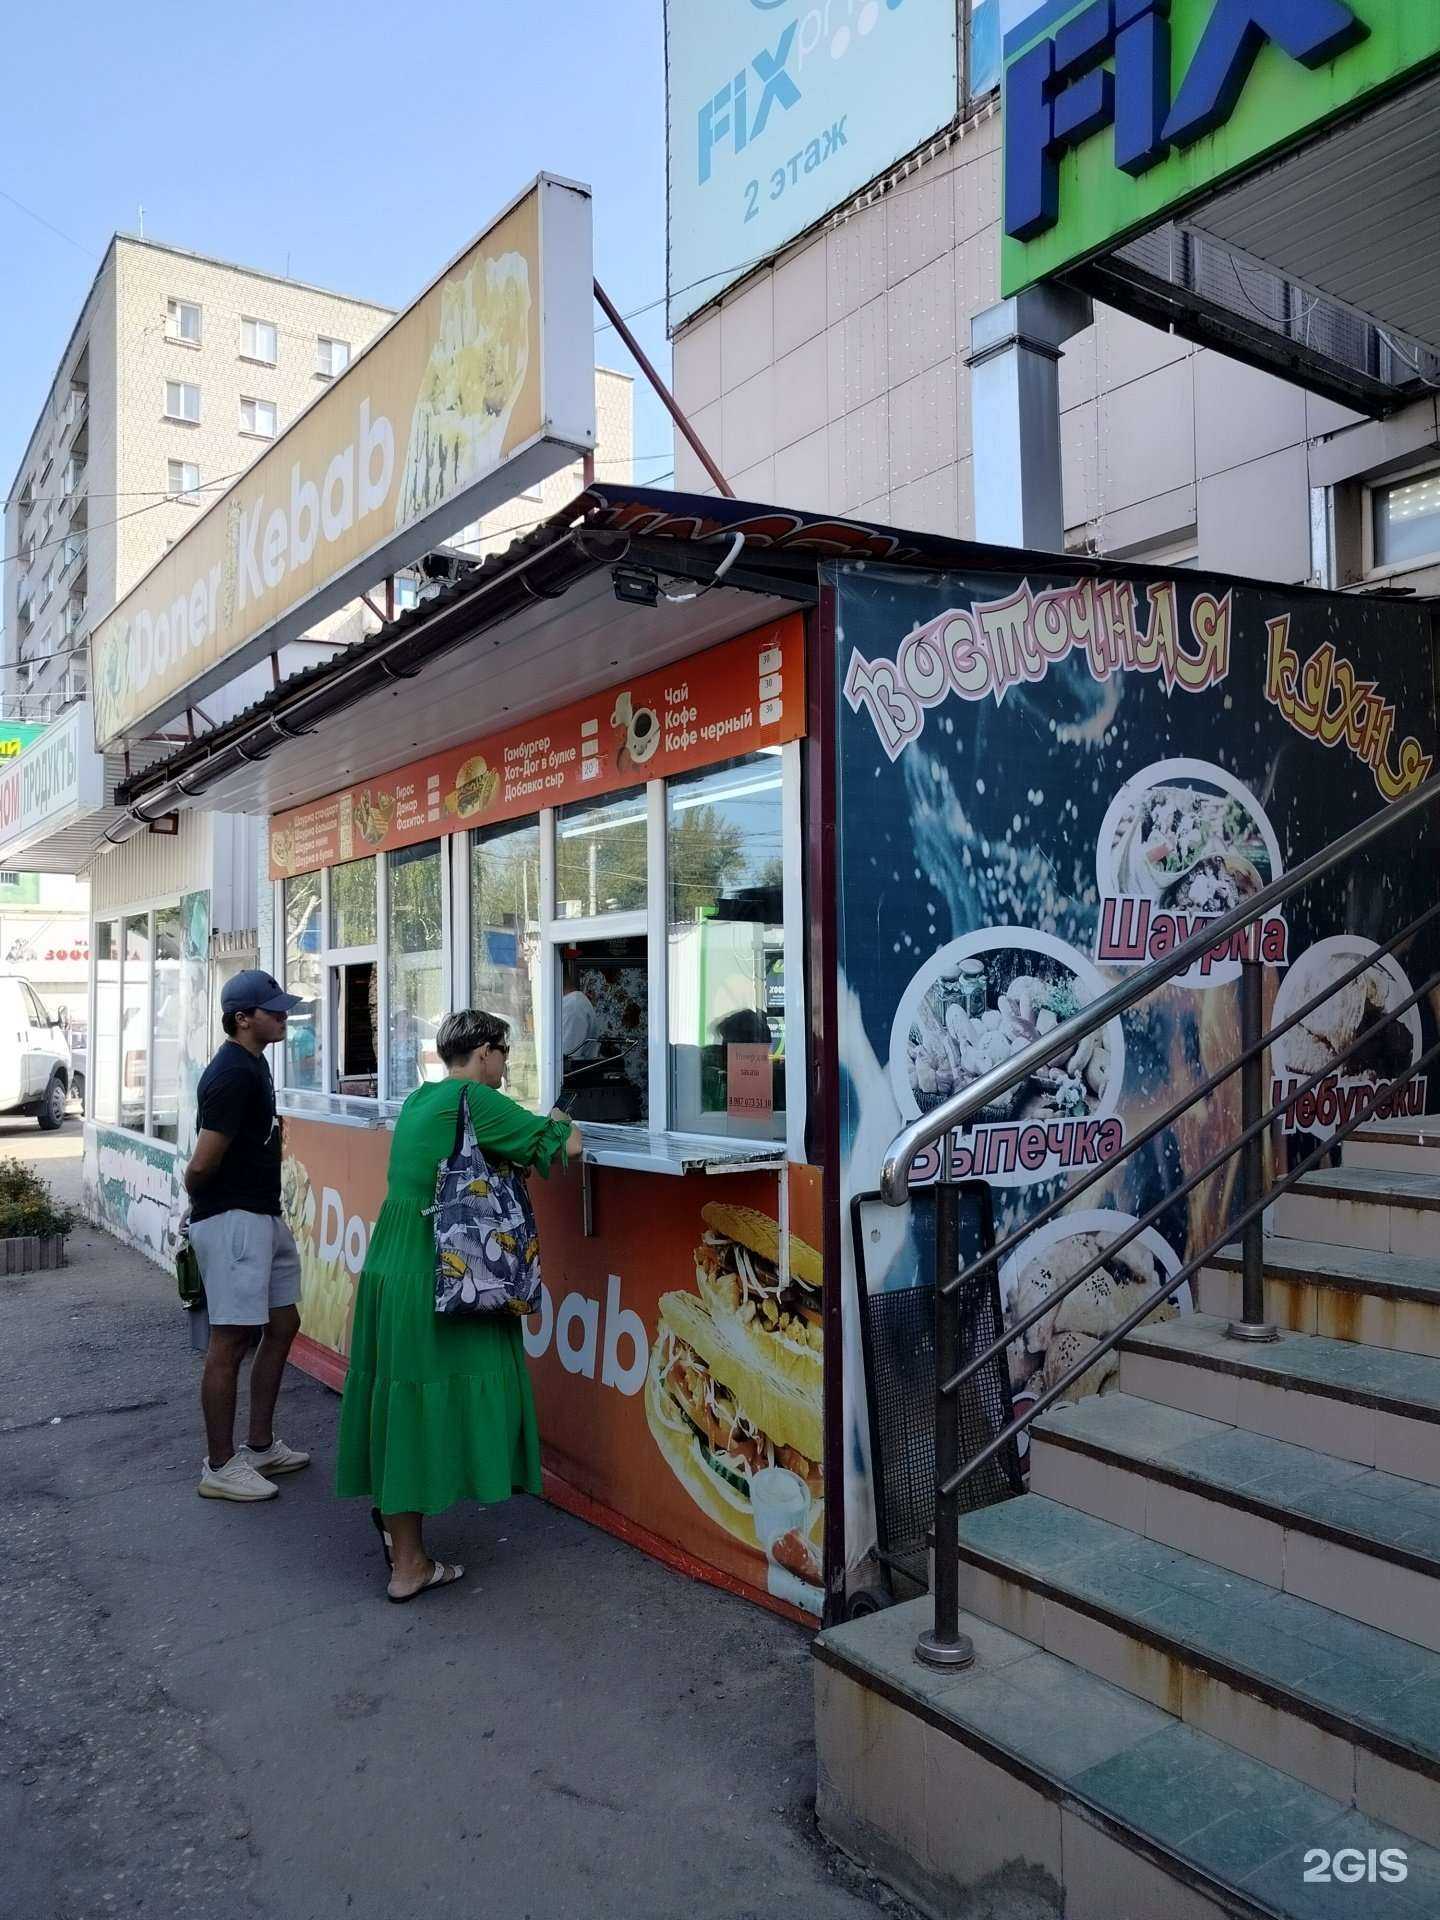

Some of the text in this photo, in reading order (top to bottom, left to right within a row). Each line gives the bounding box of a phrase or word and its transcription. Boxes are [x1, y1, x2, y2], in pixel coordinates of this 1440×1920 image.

[743, 114, 848, 225] 2 этаж
[131, 394, 396, 689] Doner Kebab
[664, 682, 689, 706] Чай
[665, 706, 698, 730] Кофе
[665, 708, 753, 753] Кофе черный
[504, 736, 551, 763] Гамбургер
[504, 747, 576, 782] Хот-Дог в булке
[23, 727, 78, 815] ПРОДУКТЫ
[504, 771, 565, 803] Добавка сыр
[908, 1118, 1123, 1182] Выпечка
